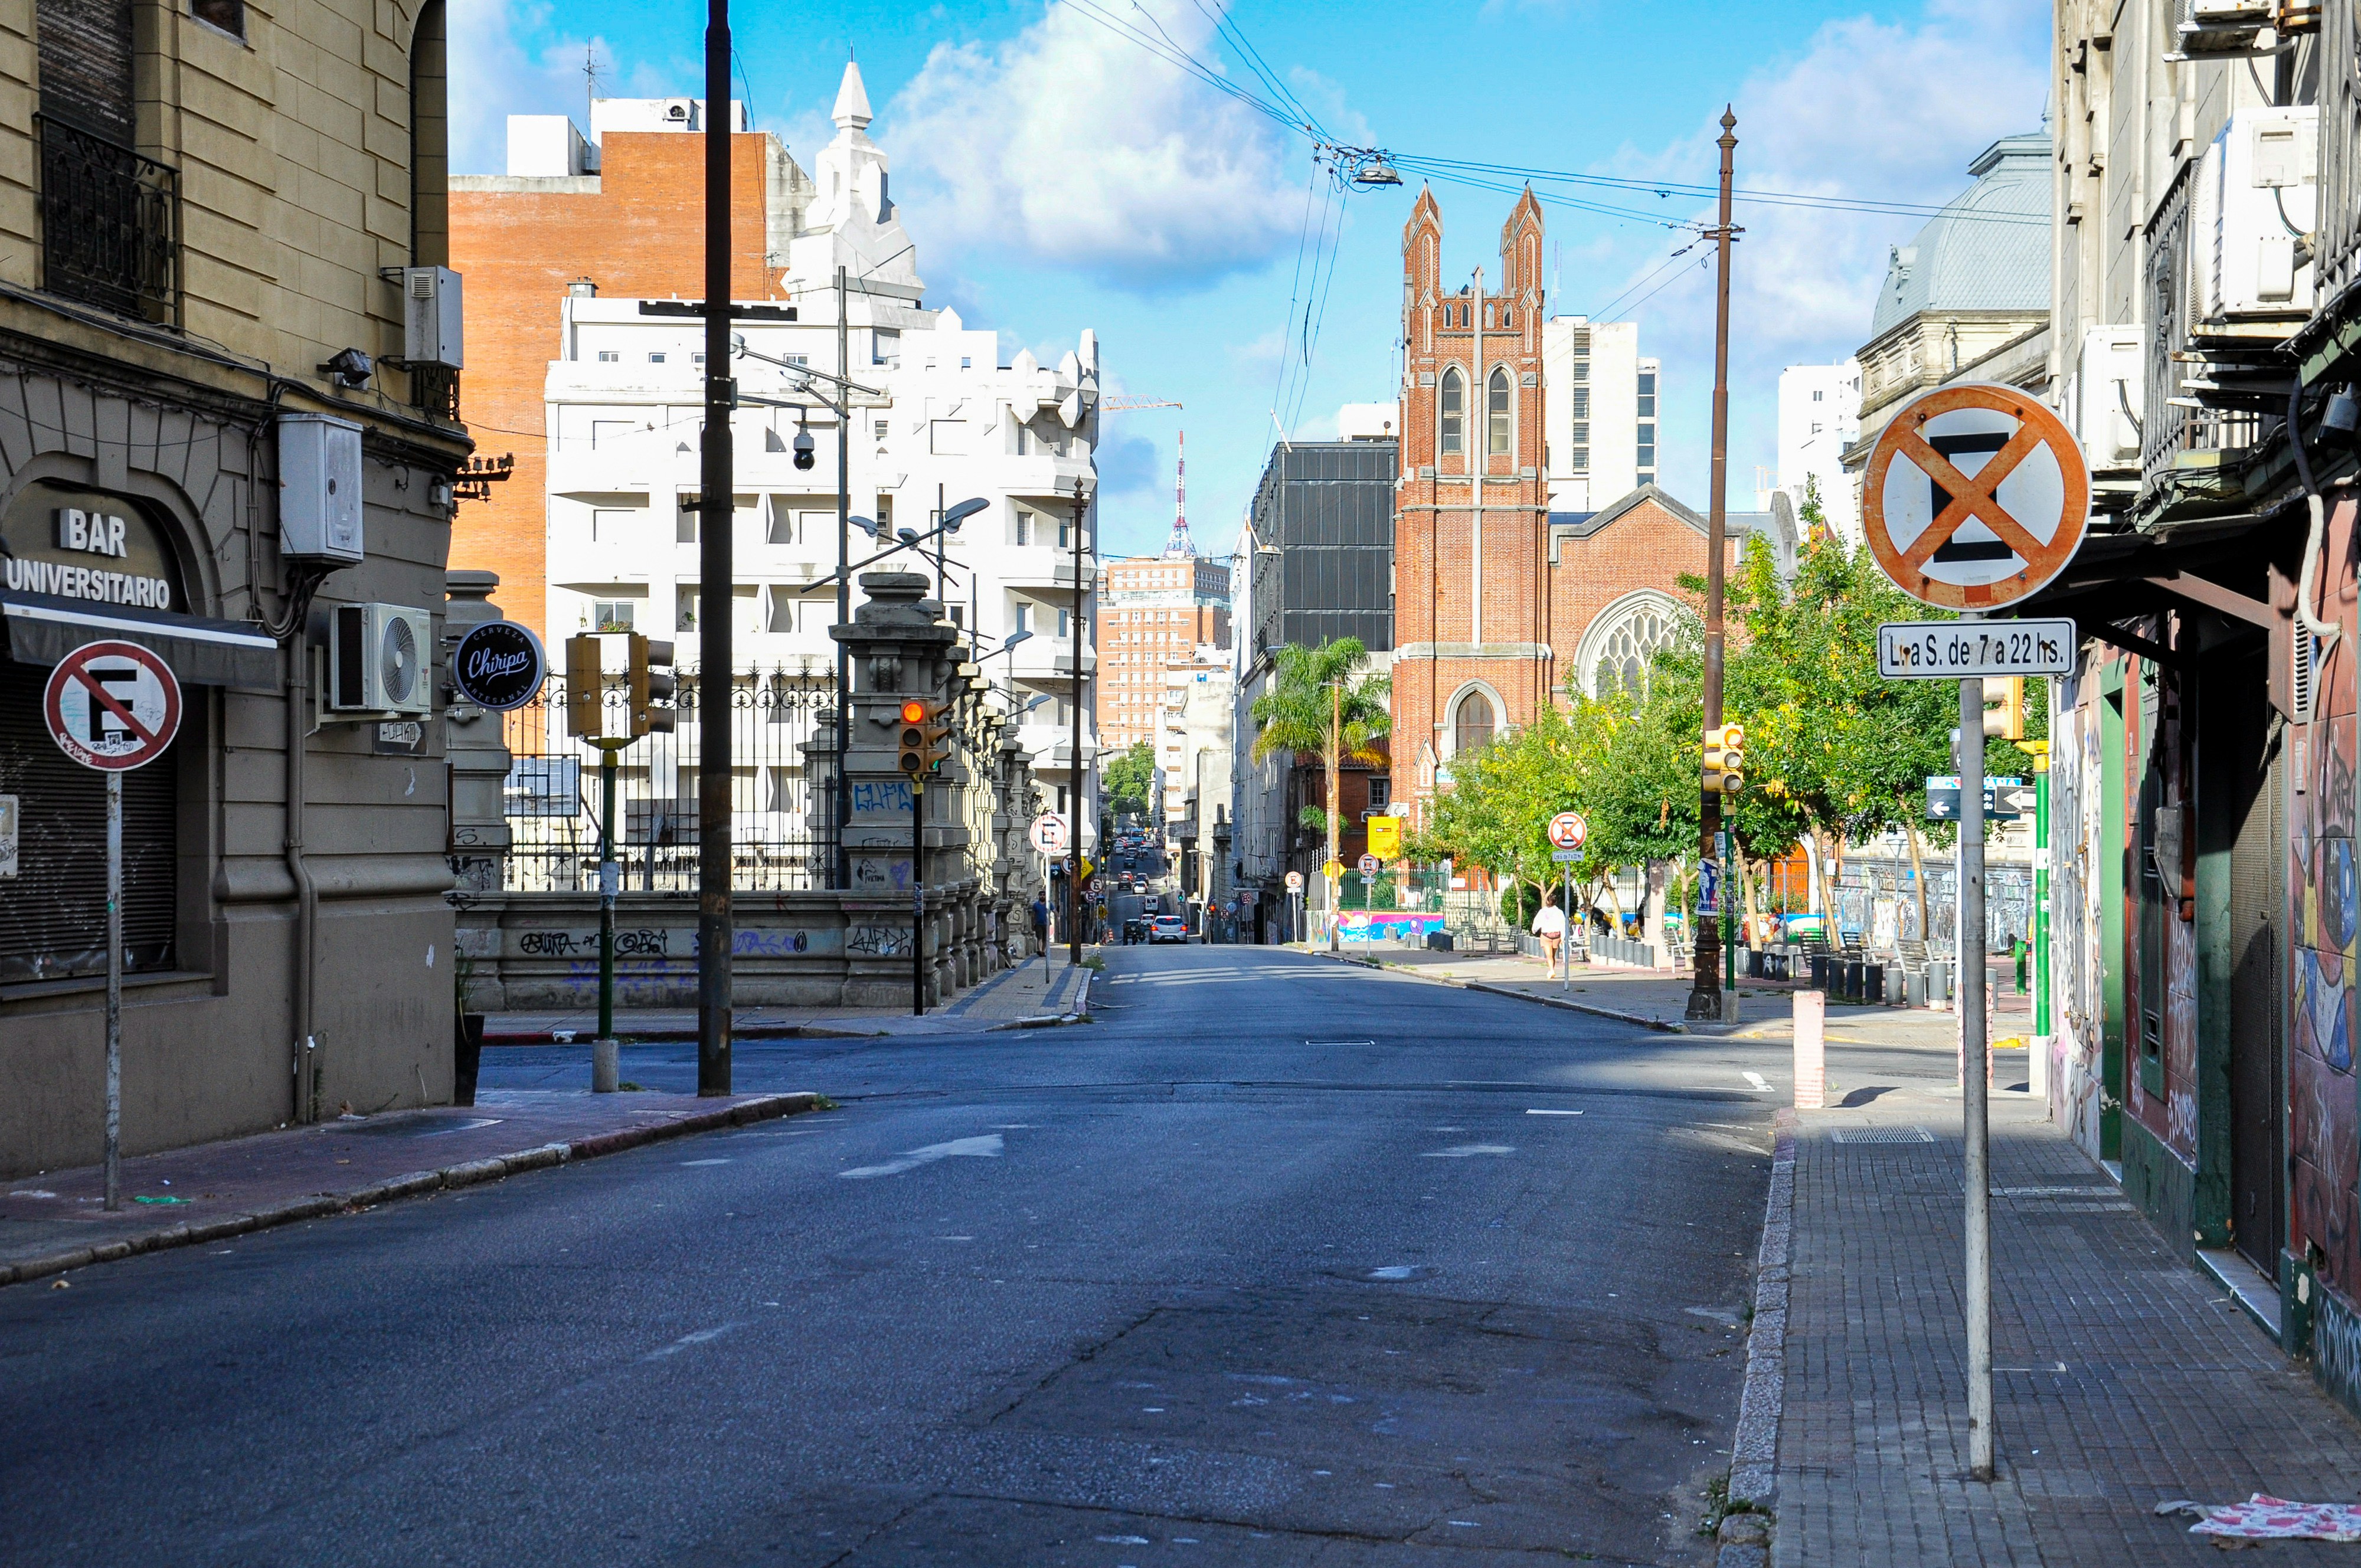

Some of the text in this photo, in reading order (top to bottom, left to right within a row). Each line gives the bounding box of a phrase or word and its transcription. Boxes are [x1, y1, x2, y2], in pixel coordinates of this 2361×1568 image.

[67, 508, 127, 558] BAR
[5, 558, 170, 610] UNIVERSITARIO
[473, 627, 525, 644] CERVEZA
[1911, 642, 1920, 666] a
[1926, 634, 1943, 666] S.
[1948, 634, 1970, 666] de
[1979, 634, 1989, 664] 7
[1995, 640, 2004, 664] a
[2010, 633, 2031, 664] 22
[2037, 633, 2064, 663] hs.
[467, 647, 530, 680] Chiripa
[89, 669, 137, 742] E
[465, 682, 528, 704] ARTESANAL
